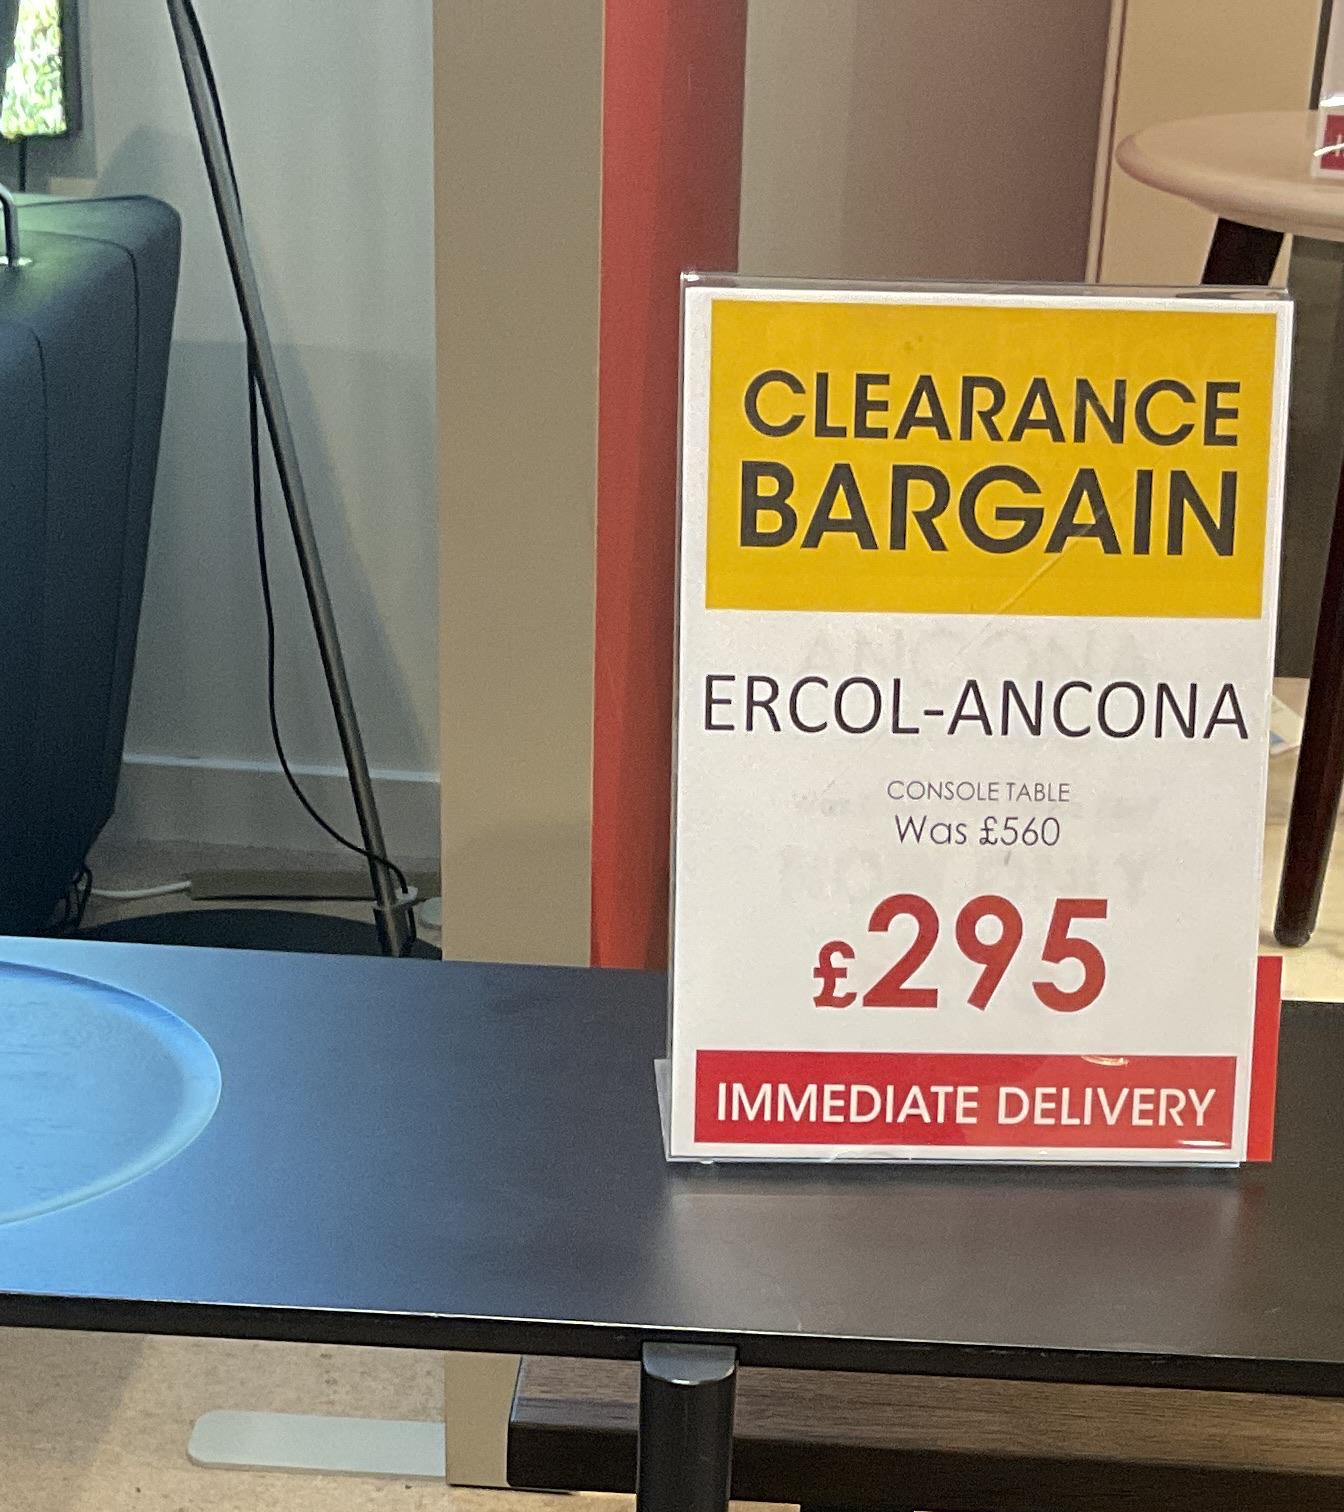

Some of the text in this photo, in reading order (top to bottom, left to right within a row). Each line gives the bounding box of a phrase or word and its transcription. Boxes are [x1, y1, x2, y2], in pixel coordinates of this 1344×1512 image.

[743, 368, 1242, 447] CLEARANCE
[739, 459, 1239, 557] BARGAIN
[703, 674, 1250, 741] ERCOL-ANCONA
[886, 780, 1071, 803] CONSOLE TABLE
[894, 814, 1061, 847] Was £560
[813, 892, 1108, 1013] £295
[716, 1081, 1217, 1128] IMMEDIATE DELIVERY
